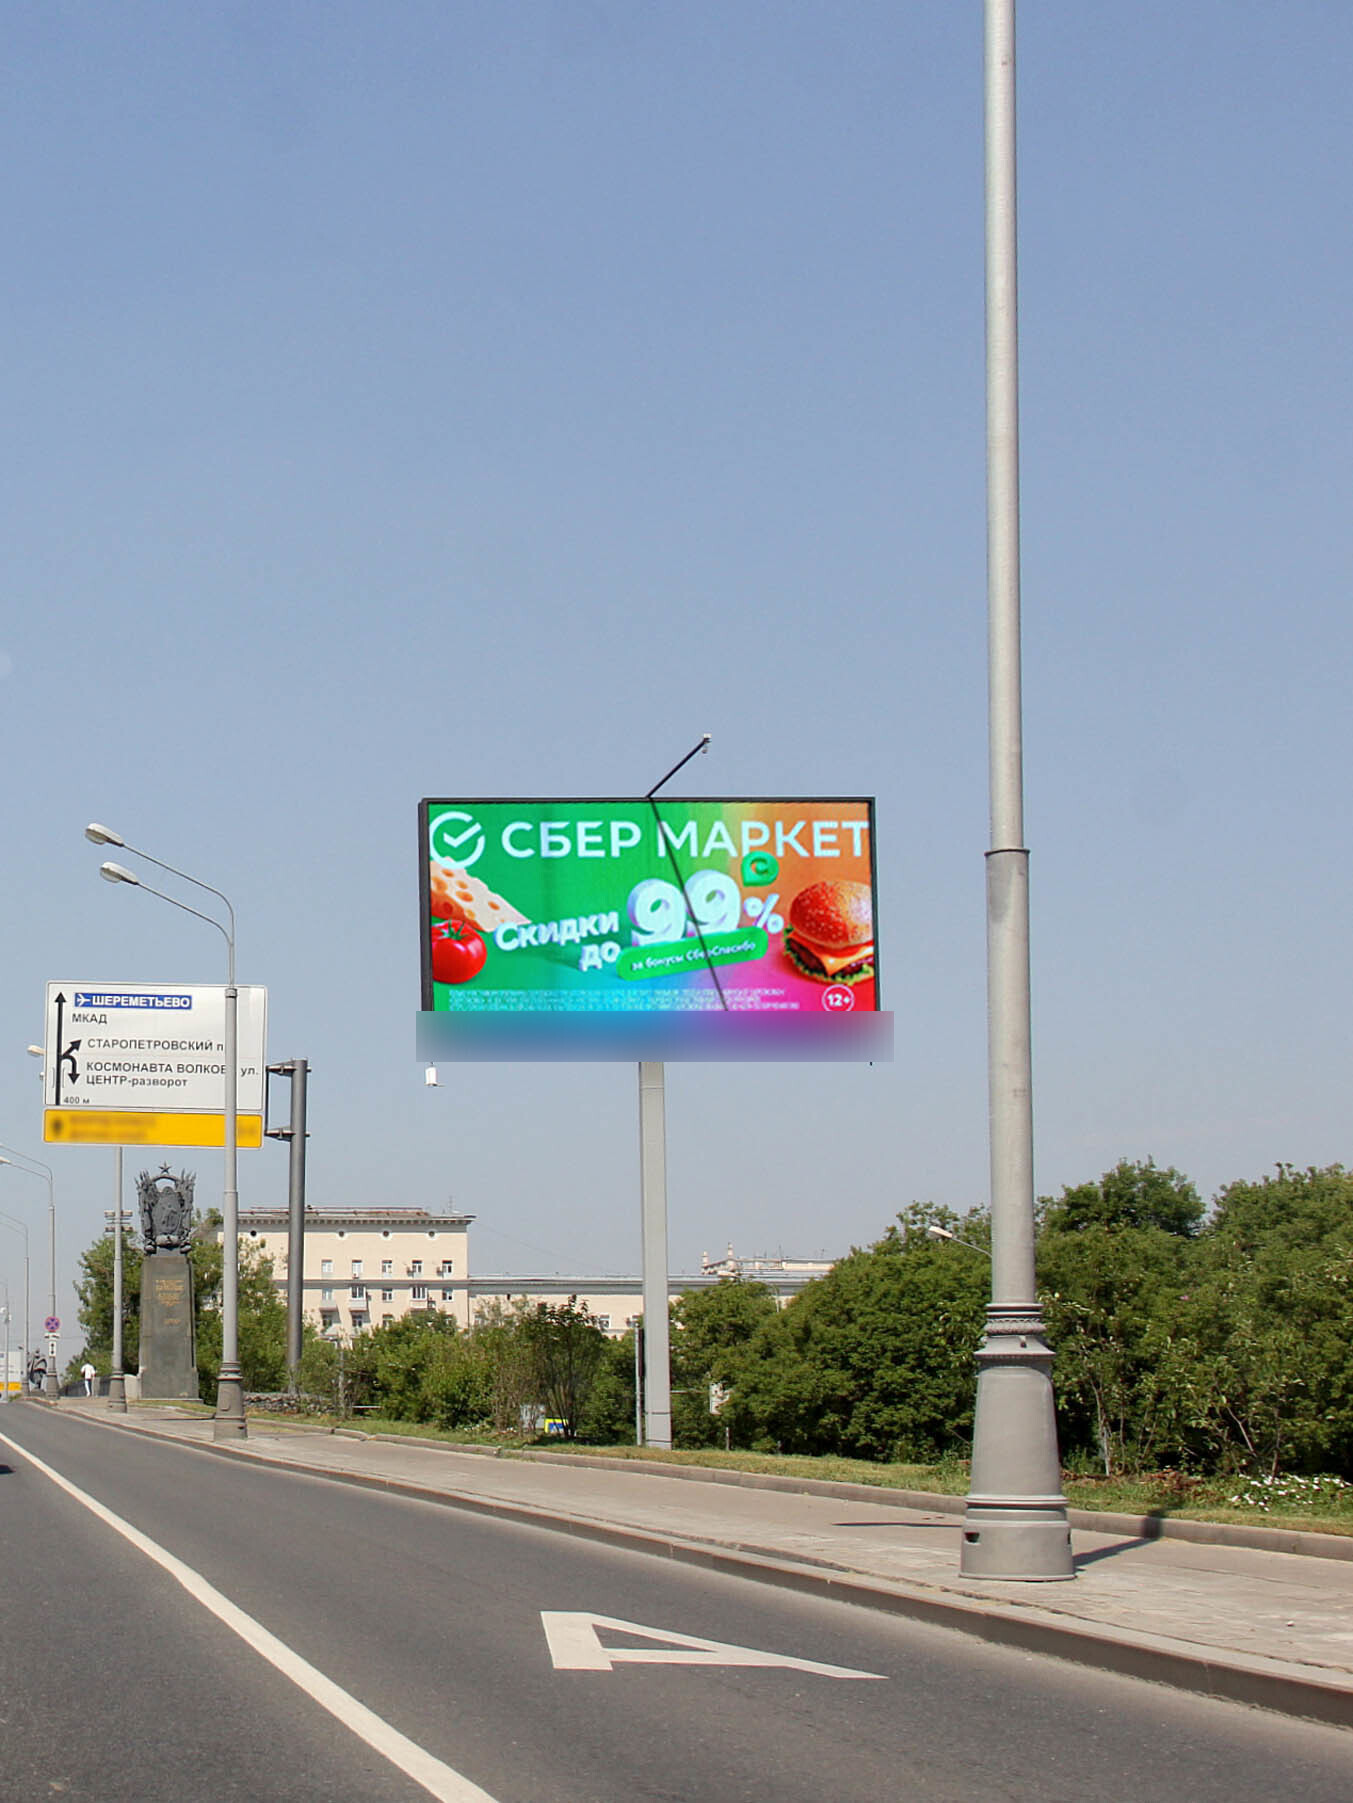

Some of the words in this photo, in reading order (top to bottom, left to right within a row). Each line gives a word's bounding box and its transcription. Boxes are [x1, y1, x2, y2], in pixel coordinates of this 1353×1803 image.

[501, 820, 642, 858] СБЕР
[657, 820, 870, 858] МАРКЕТ
[494, 911, 620, 951] Скидки
[578, 941, 622, 972] до
[645, 954, 684, 968] бонусы
[92, 995, 190, 1008] ШЕРЕМЕТЬЕВО
[827, 993, 850, 1006] 12+
[72, 1013, 108, 1024] МКАД
[88, 1038, 213, 1051] СТАРОПЕТРОВСКИЙ
[86, 1061, 173, 1073] КОСМОНАВТА
[240, 1067, 260, 1077] ул.
[86, 1074, 188, 1088] ЦЕНТР-разворот
[63, 1096, 80, 1105] 400
